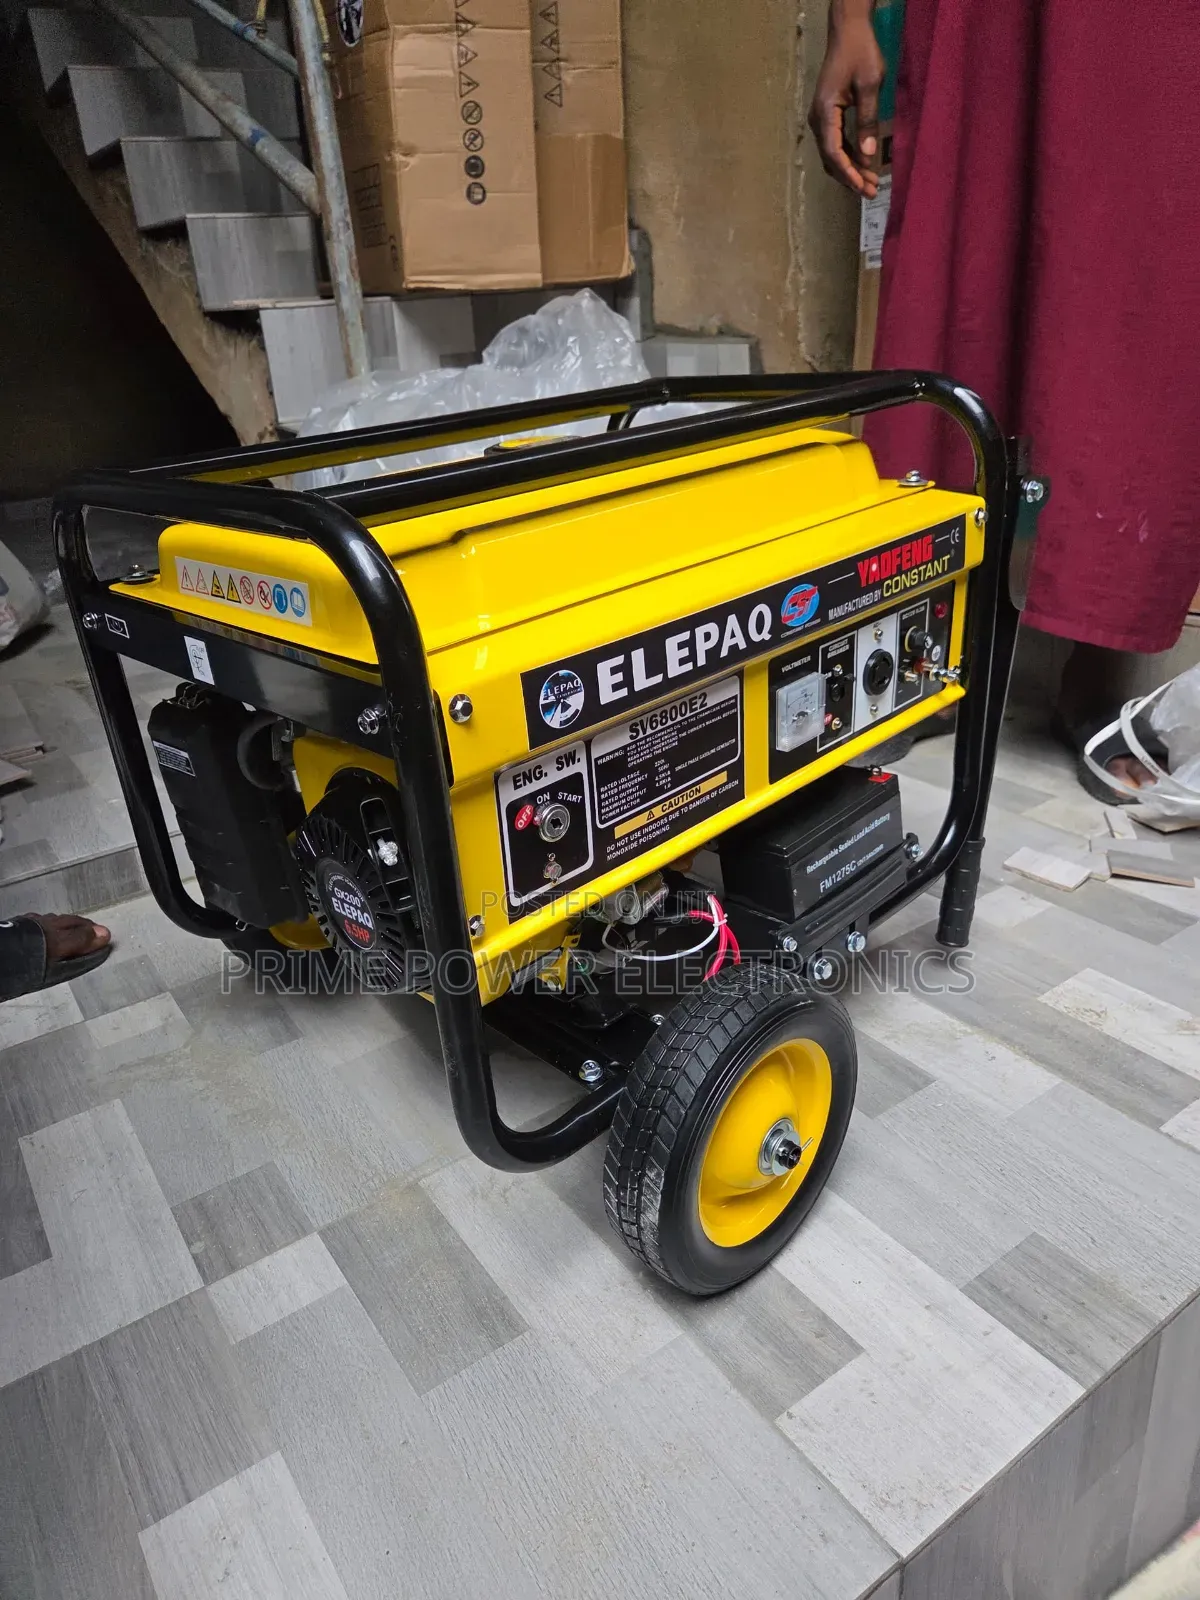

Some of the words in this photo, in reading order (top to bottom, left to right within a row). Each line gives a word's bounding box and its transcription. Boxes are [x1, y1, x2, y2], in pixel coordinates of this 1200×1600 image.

[857, 534, 934, 588] YAOFENG
[828, 594, 873, 621] MANUFACTURED
[873, 589, 882, 601] BY
[882, 554, 950, 598] CONSTANT
[596, 603, 773, 705] ELEPAQ
[781, 655, 811, 673] VOLTMETER
[628, 691, 708, 741] SV6800E2
[512, 764, 548, 791] ENG.
[555, 749, 581, 772] SW.
[597, 750, 625, 765] WARNING:
[536, 791, 550, 805] ON
[557, 791, 582, 804] START
[600, 780, 618, 793] RATED
[600, 787, 618, 800] RATED
[618, 773, 648, 791] FREQUENCY
[601, 795, 619, 807] RATED
[618, 785, 639, 799] OUTPUT
[661, 785, 701, 813] CAUTION
[601, 798, 626, 814] MAXIMUM
[626, 787, 647, 801] OUTPUT
[620, 798, 641, 812] FACTOR
[517, 805, 534, 829] OFF
[606, 845, 615, 853] DO
[616, 836, 629, 848] NOT
[630, 830, 641, 841] USE
[642, 818, 668, 834] INDOORS
[668, 810, 680, 821] DUE
[680, 806, 688, 815] TO
[689, 794, 710, 810] DANGER
[710, 790, 718, 798] OF
[718, 779, 739, 796] CARBON
[606, 841, 638, 861] MONOXIDE
[639, 824, 670, 844] POISONING
[806, 848, 839, 875] Rechargeable
[838, 836, 854, 853] Sealed
[853, 828, 865, 842] Lead
[864, 821, 875, 834] Acid
[874, 812, 890, 828] Battery
[819, 860, 857, 893] FM1275C
[333, 887, 361, 907] GX200
[331, 897, 374, 930] ELEPAQ
[344, 919, 370, 943] 6.5HP
